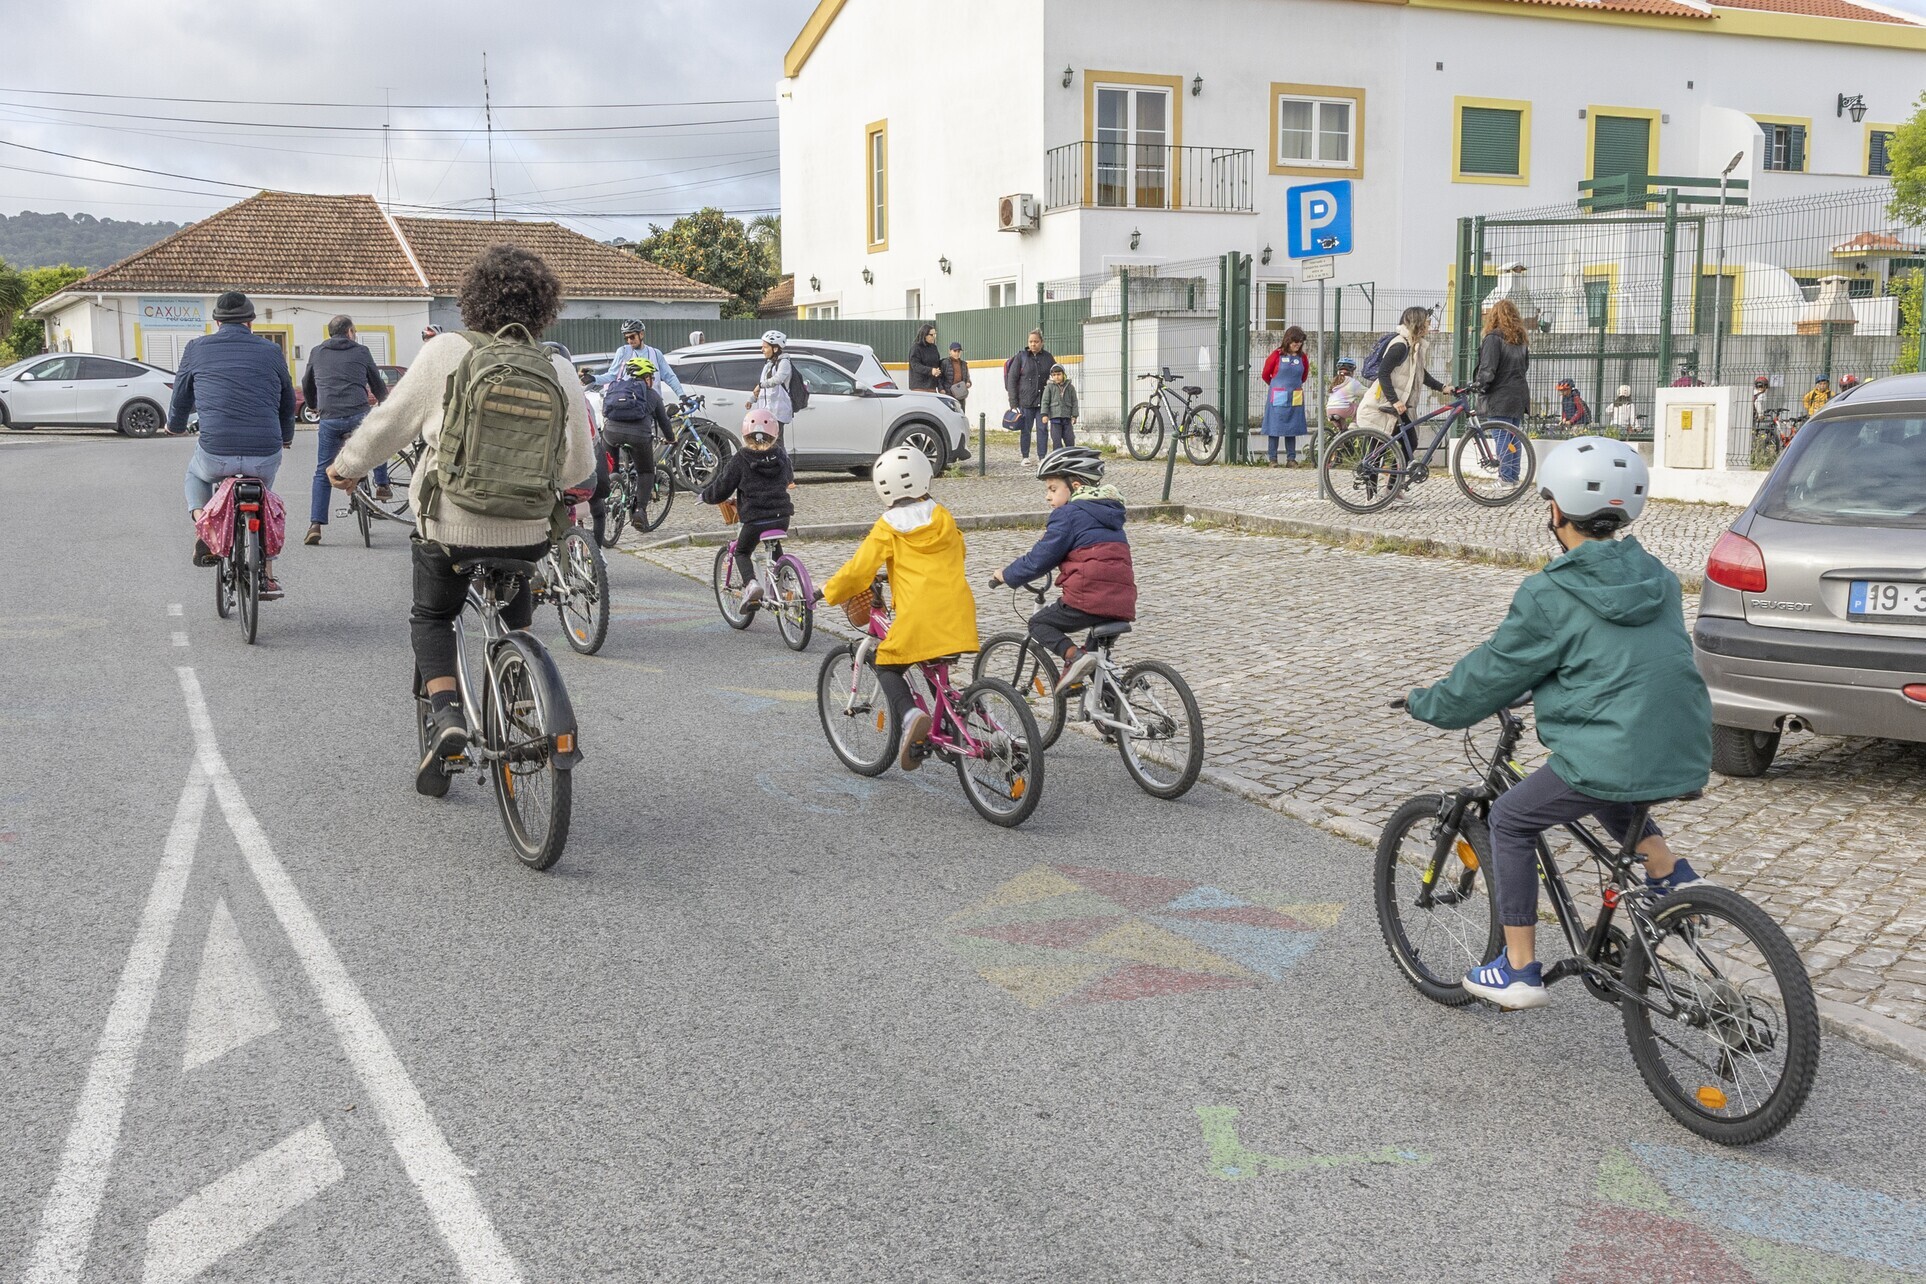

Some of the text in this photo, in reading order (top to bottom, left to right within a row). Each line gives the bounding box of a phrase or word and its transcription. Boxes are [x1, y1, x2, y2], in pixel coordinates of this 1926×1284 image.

[1301, 190, 1337, 250] P
[144, 306, 199, 317] CAXUXA
[1751, 599, 1813, 612] PEUGEOT
[1854, 600, 1862, 608] P
